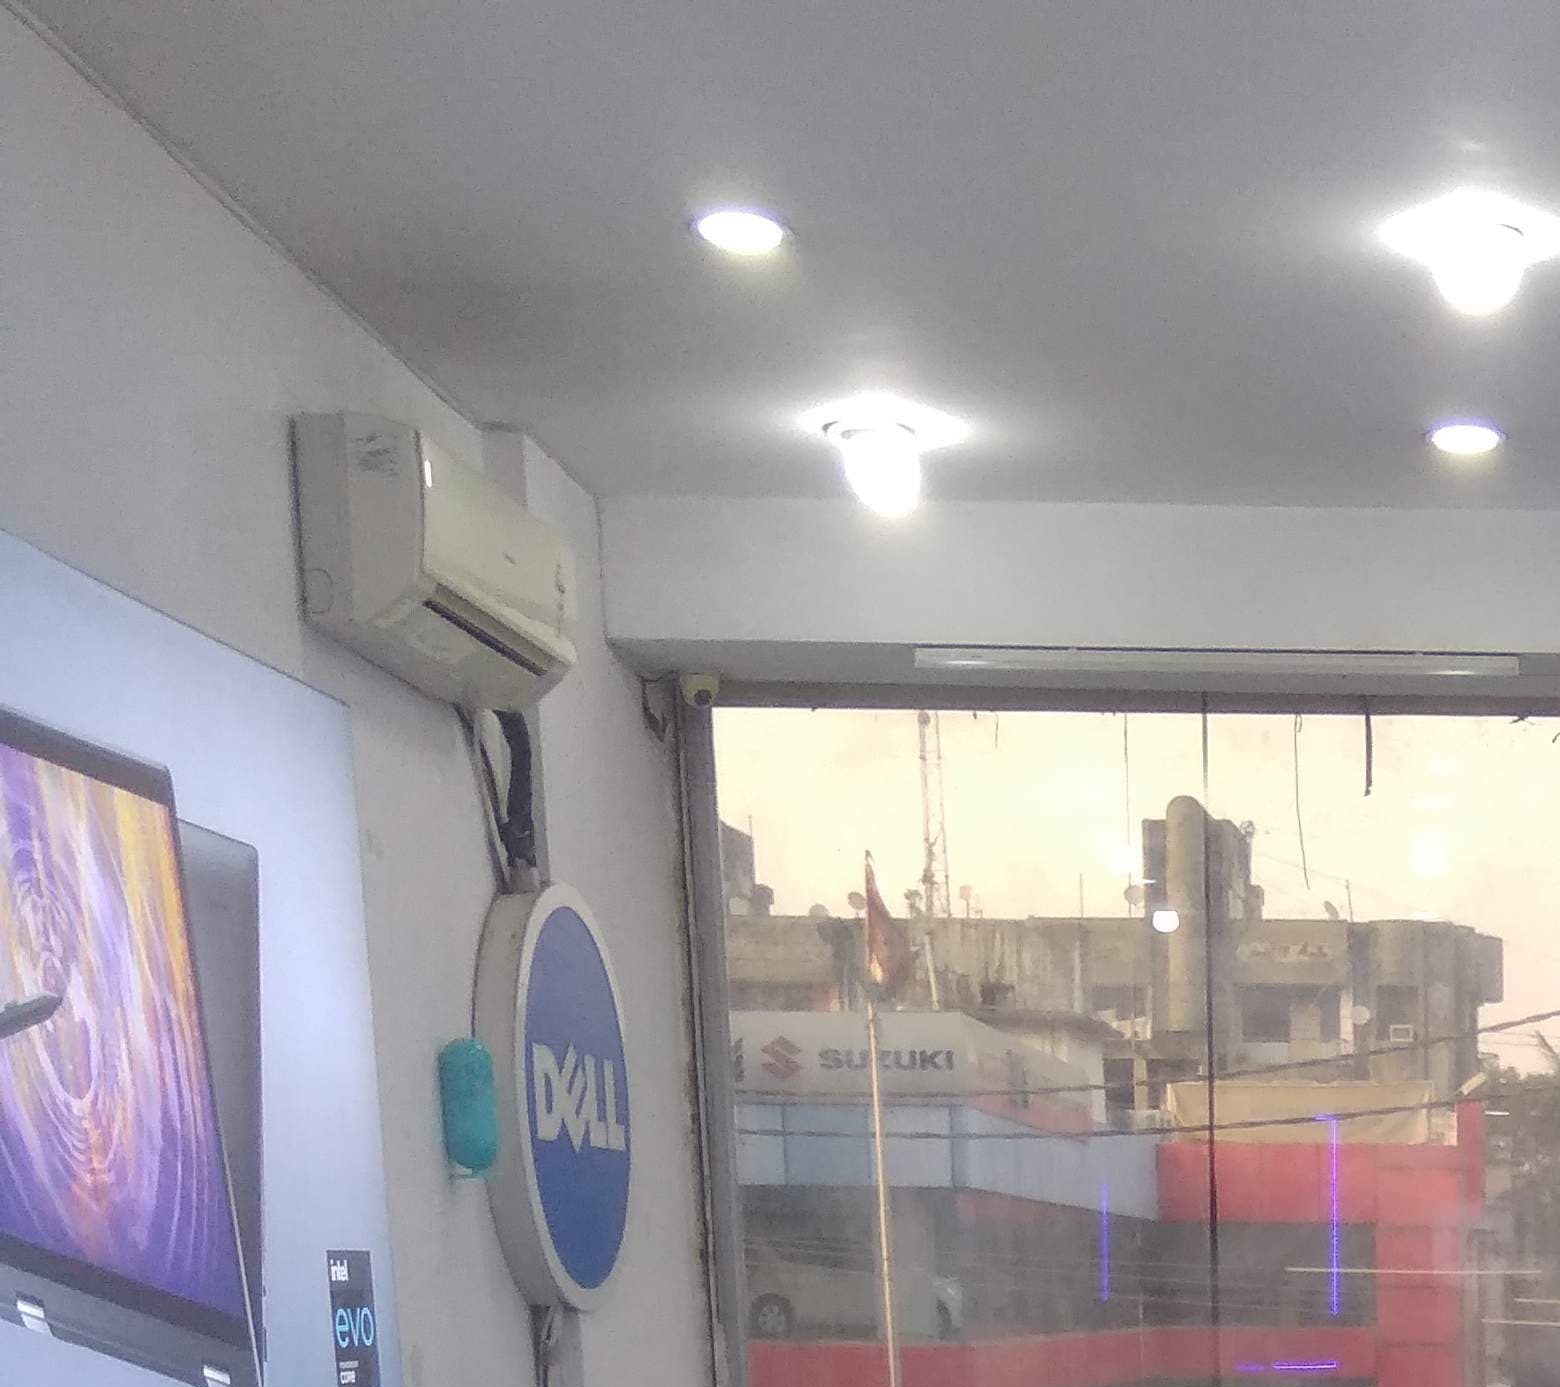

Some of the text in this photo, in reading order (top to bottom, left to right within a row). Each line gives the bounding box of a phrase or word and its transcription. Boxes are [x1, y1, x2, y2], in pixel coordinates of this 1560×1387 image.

[818, 1048, 955, 1072] SUZUKI
[532, 1040, 625, 1153] DELL
[336, 1306, 375, 1348] evo
